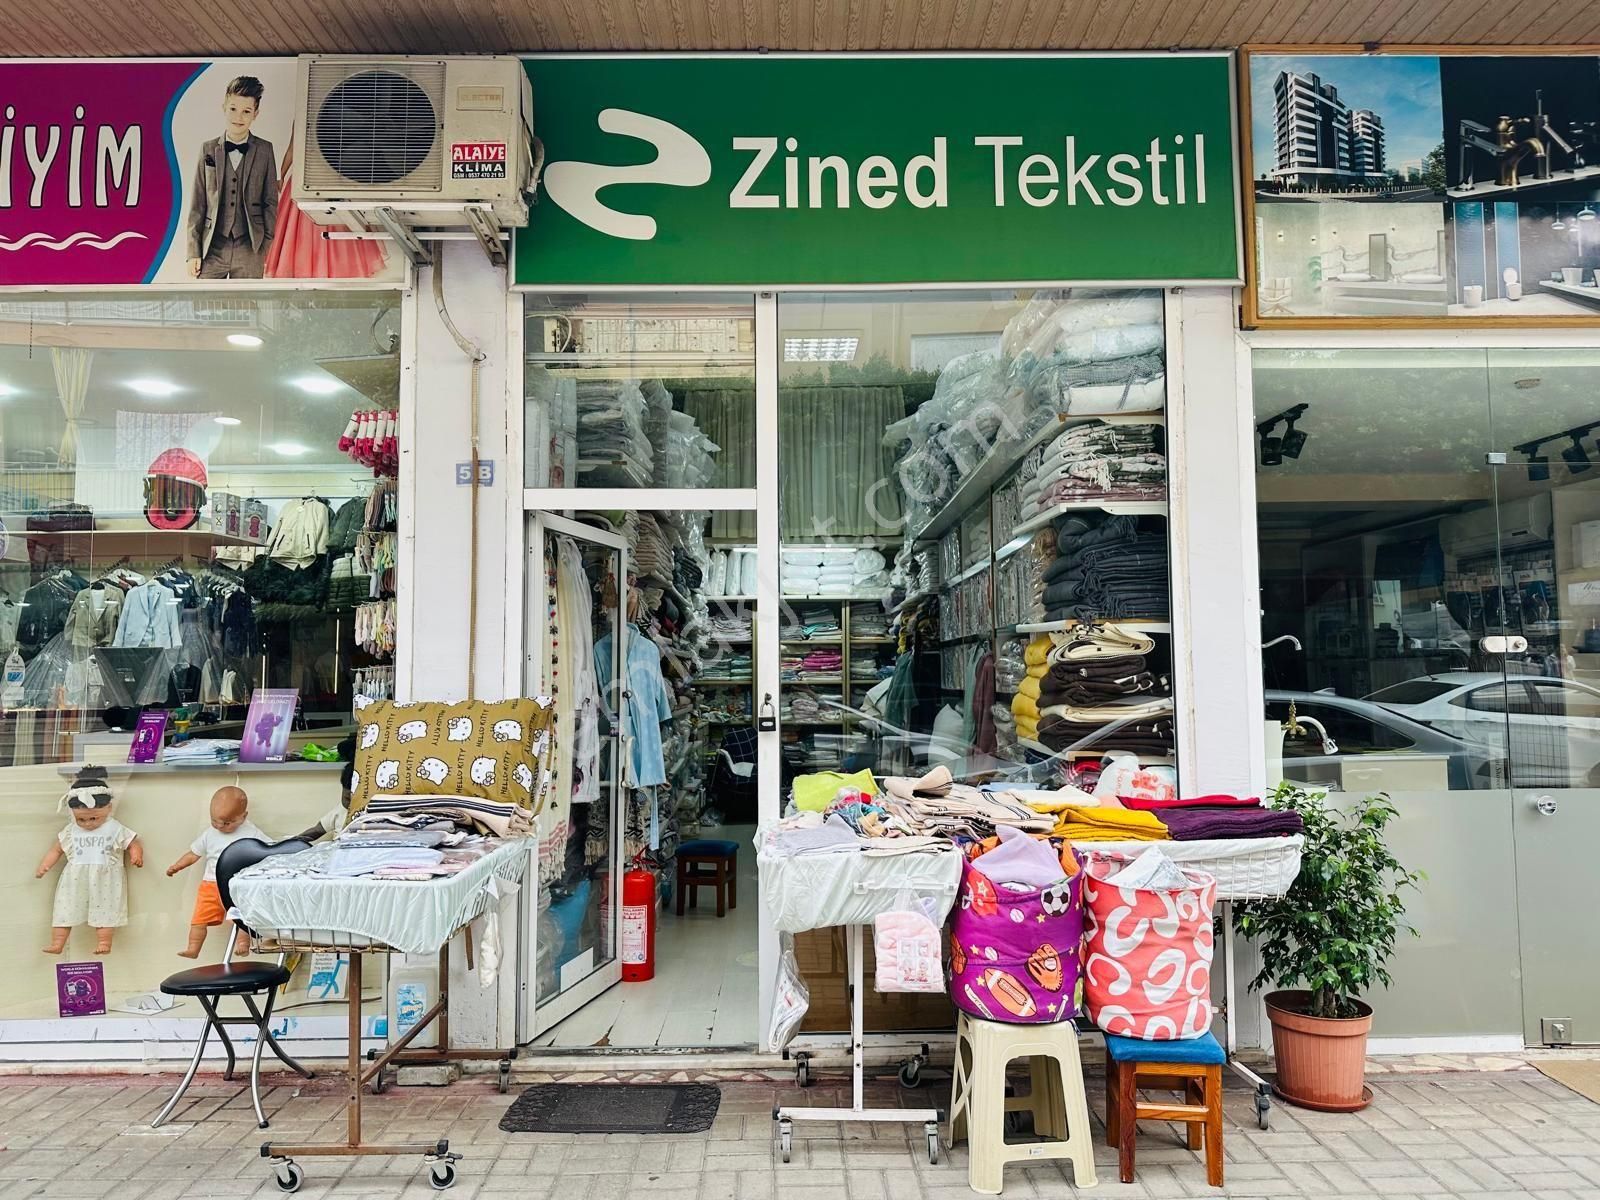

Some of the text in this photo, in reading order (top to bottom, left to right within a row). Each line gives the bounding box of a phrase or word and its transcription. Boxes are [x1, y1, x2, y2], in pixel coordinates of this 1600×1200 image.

[453, 145, 505, 161] ALAİYE
[454, 162, 503, 172] KLİMA
[729, 134, 1207, 209] Zined Tekstil
[459, 465, 492, 480] 5 B
[381, 713, 396, 752] HELLO KITTY
[431, 709, 446, 746] HELLO KITTY
[476, 709, 489, 747] HELLO KITTY
[406, 750, 415, 771] KITTY
[457, 748, 466, 770] KITTY
[501, 750, 511, 795] HELLO KITTY
[362, 755, 373, 799] HELLO KITTY
[79, 836, 105, 848] USPA
